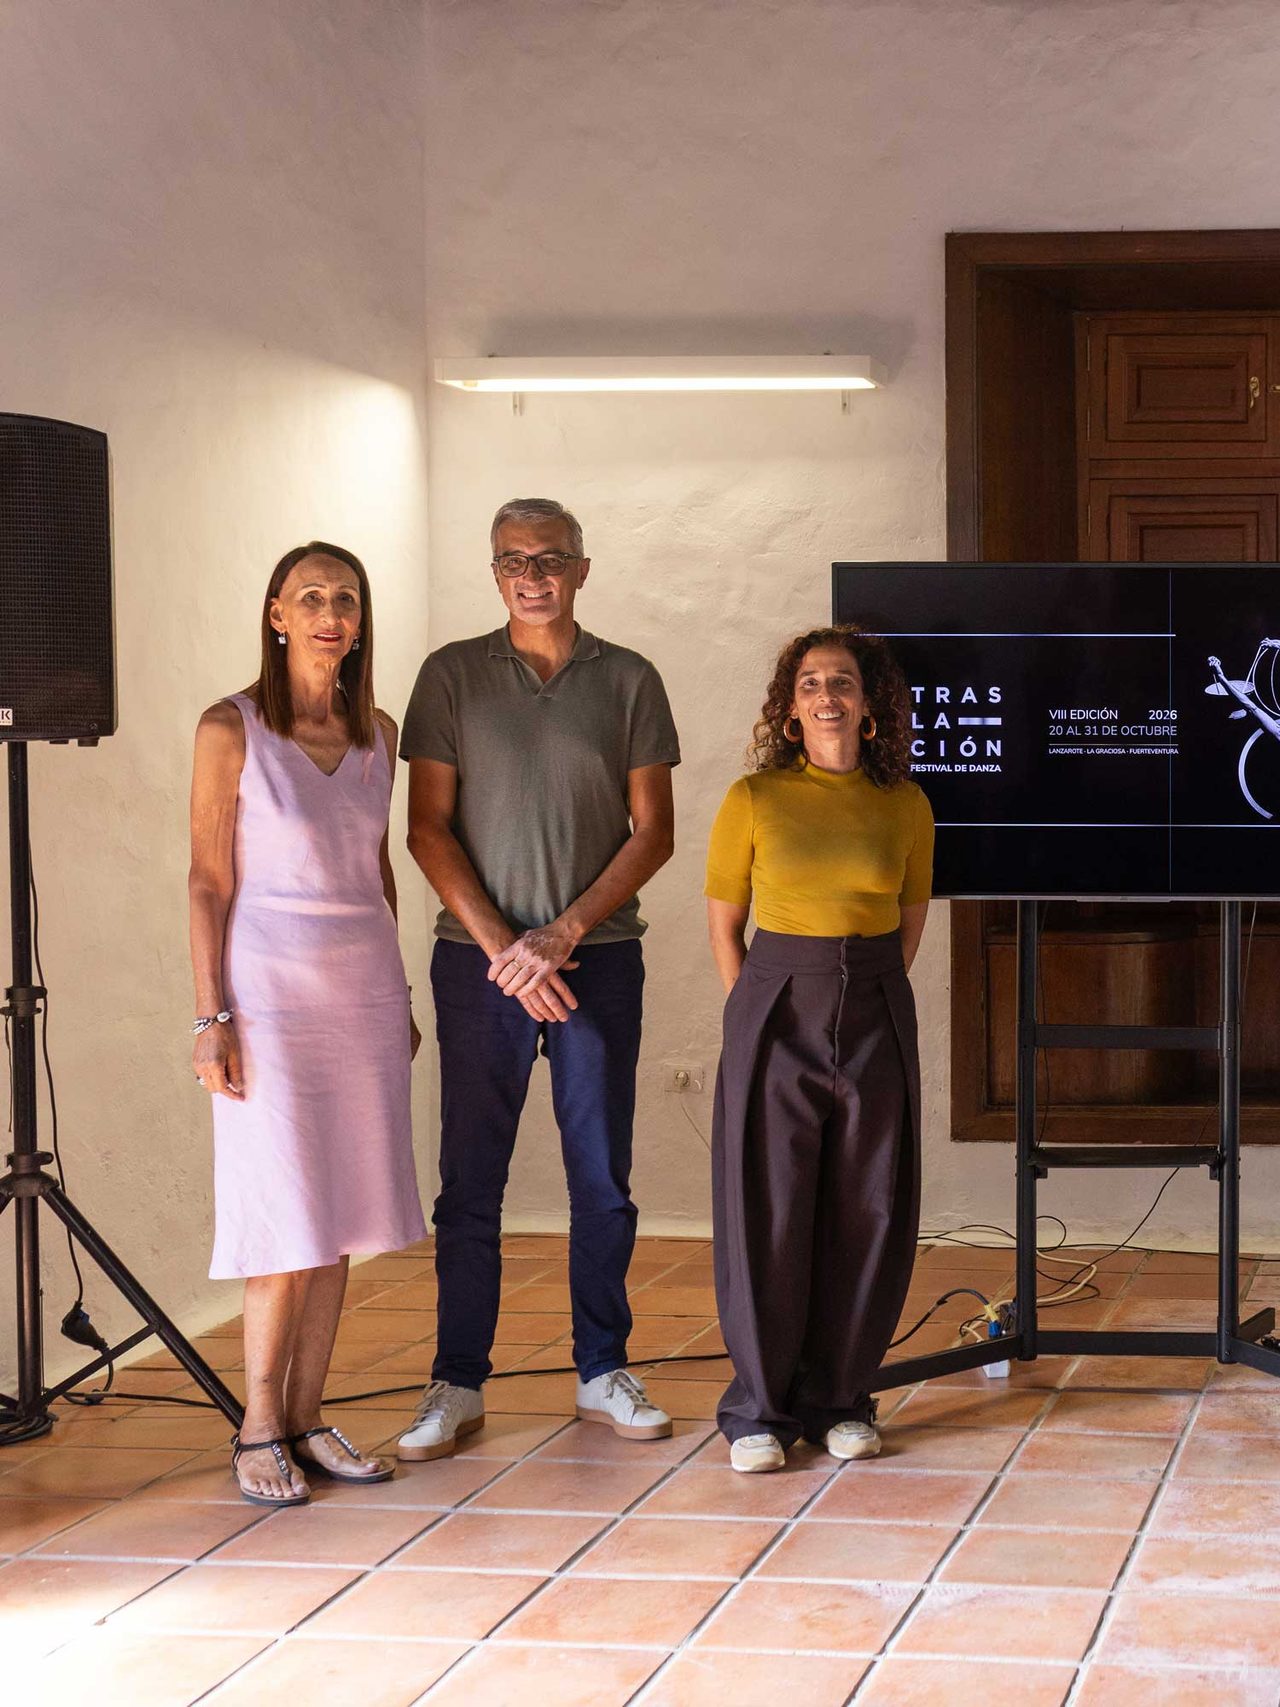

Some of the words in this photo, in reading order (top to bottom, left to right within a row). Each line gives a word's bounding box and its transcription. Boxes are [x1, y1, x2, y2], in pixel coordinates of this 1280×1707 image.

[911, 686, 1001, 703] TRAS
[911, 712, 951, 729] LA
[1049, 709, 1067, 720] VIII
[1070, 707, 1118, 720] EDICIÓN
[1149, 709, 1178, 720] 2026
[1049, 725, 1063, 736] 20
[1066, 725, 1081, 736] AL
[1085, 725, 1098, 736] 31
[1102, 725, 1118, 736] DE
[1121, 725, 1178, 736] OCTUBRE
[911, 736, 1002, 757] CIÓN
[910, 764, 952, 772] FESTIVAL
[954, 764, 967, 772] DE
[969, 764, 1002, 772] DANZA
